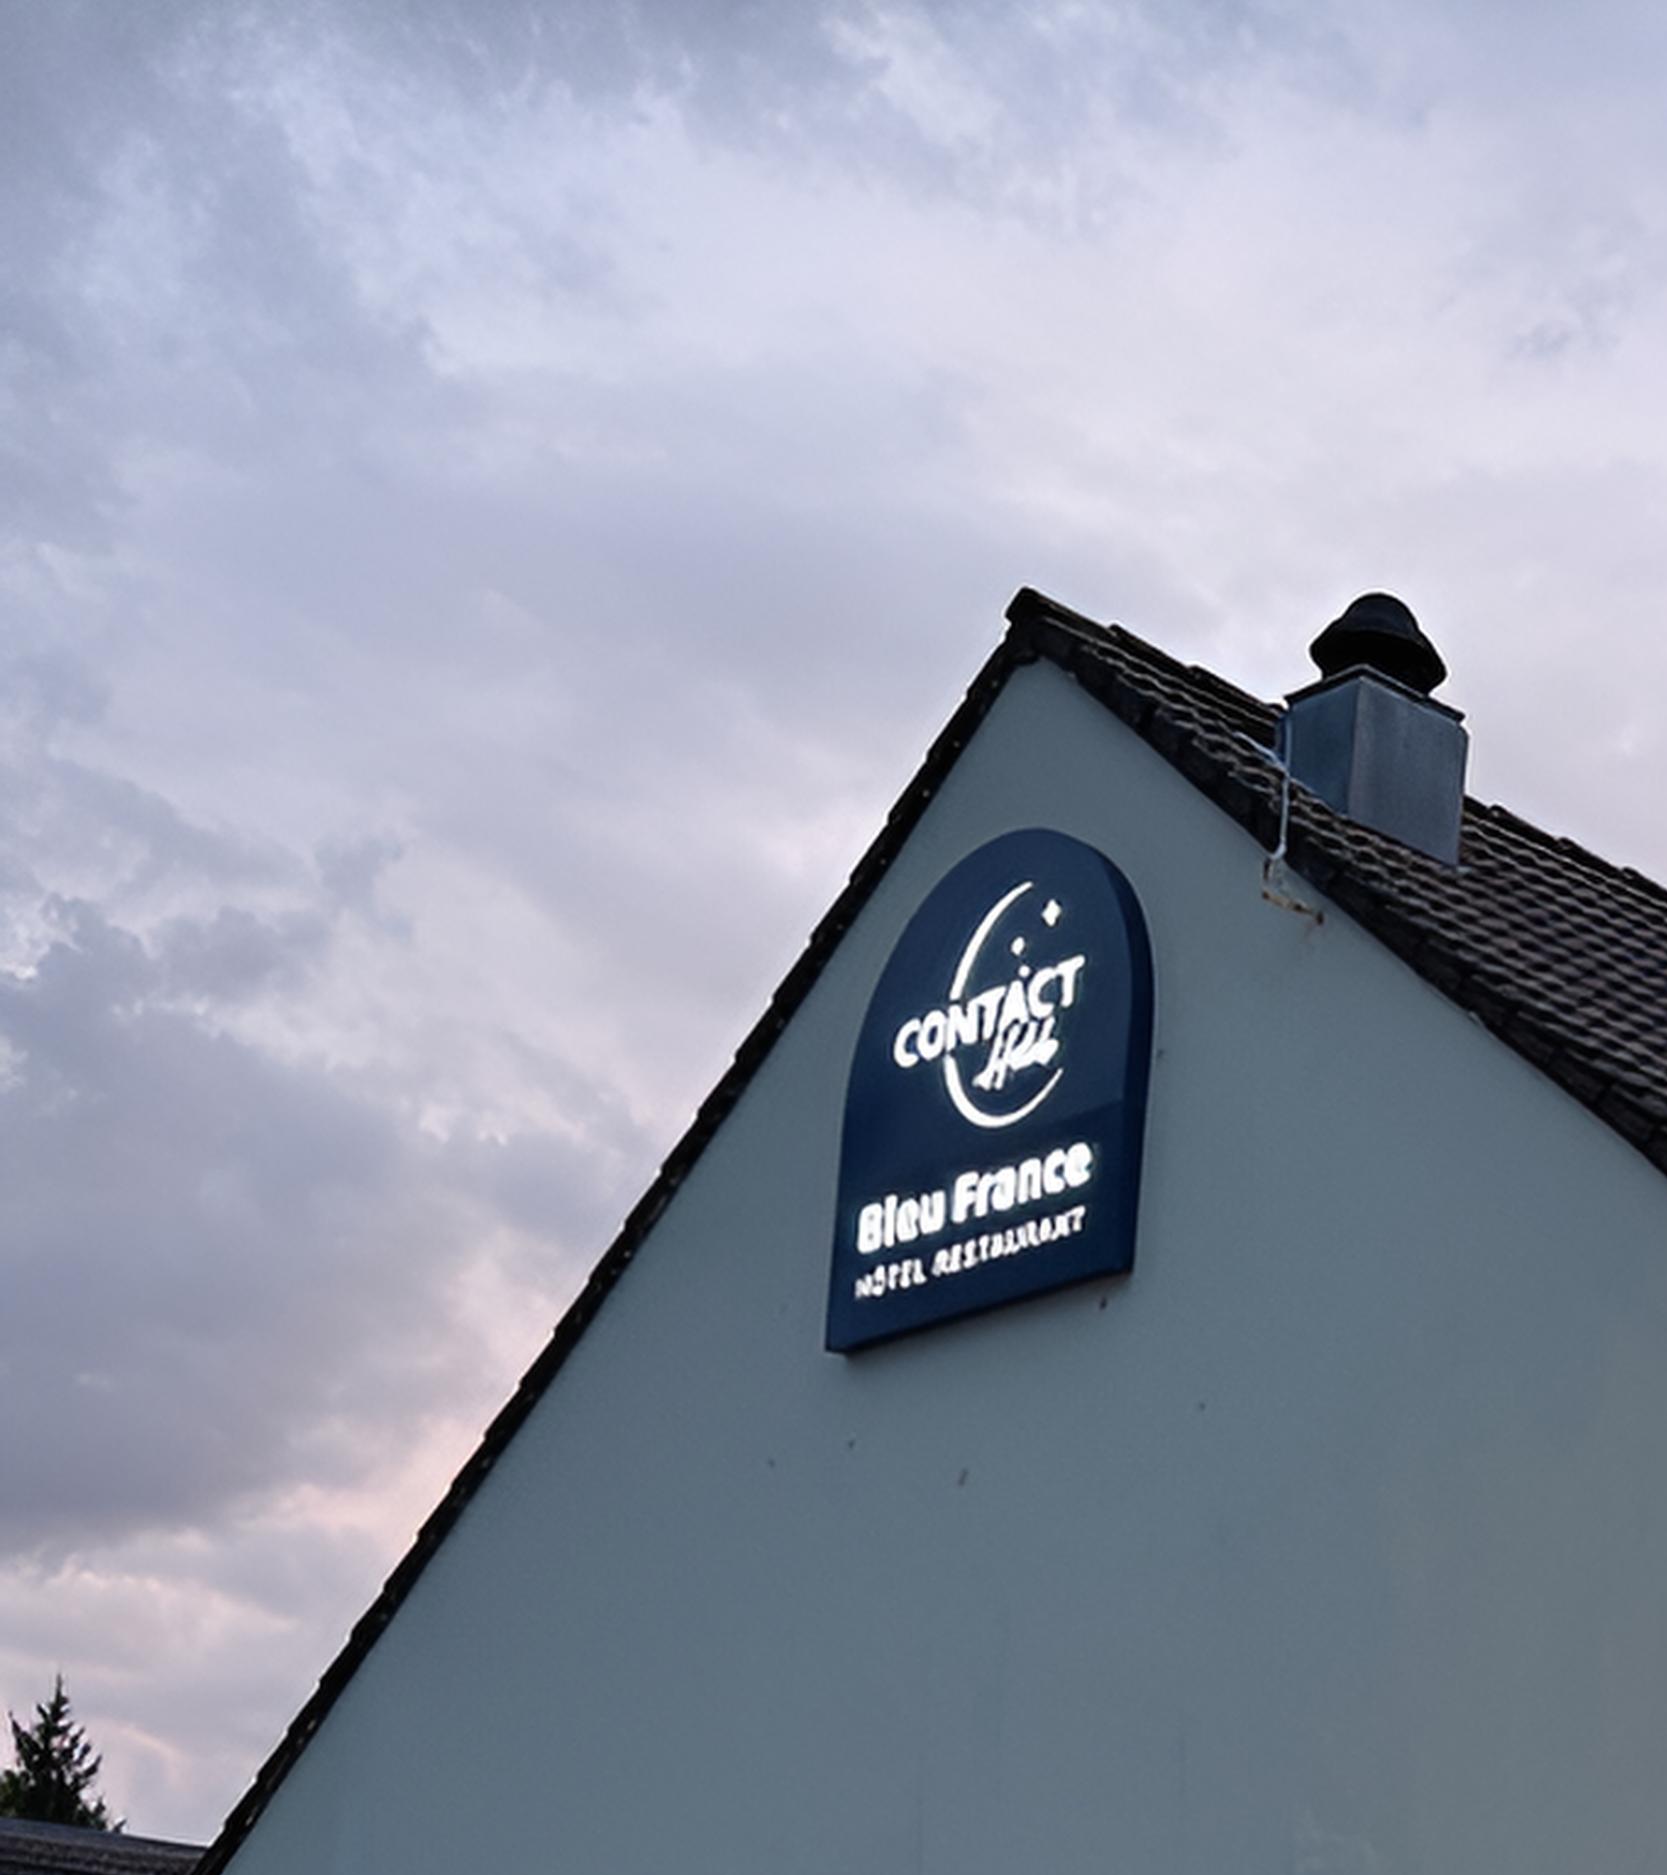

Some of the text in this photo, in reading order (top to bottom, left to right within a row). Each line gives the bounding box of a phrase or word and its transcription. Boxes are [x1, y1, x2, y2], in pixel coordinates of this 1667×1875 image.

[894, 955, 1085, 1068] CONTACT
[856, 1142, 1094, 1255] Bleu France
